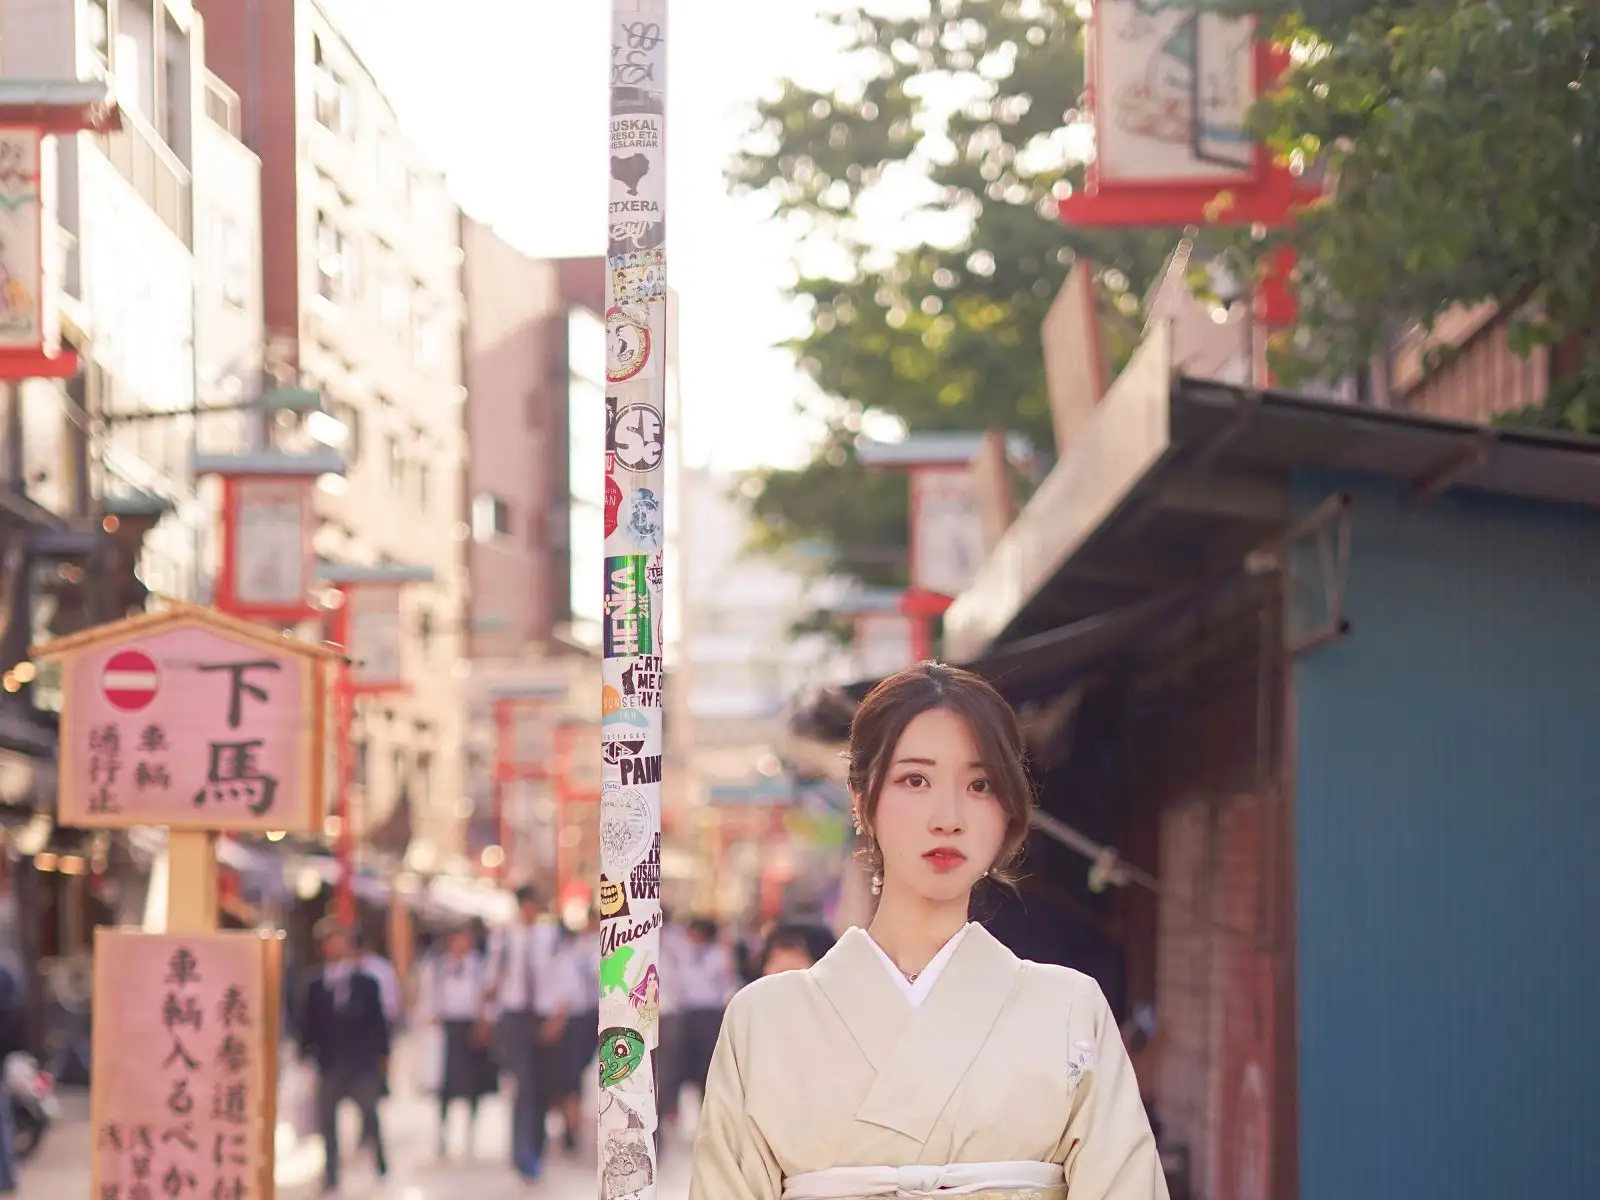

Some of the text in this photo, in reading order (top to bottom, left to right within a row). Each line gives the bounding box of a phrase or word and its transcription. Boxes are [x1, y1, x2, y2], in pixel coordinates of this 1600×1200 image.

[610, 131, 658, 141] RESO ETA
[609, 200, 659, 213] ETXERA
[638, 673, 655, 689] ME
[194, 660, 280, 817] 下馬
